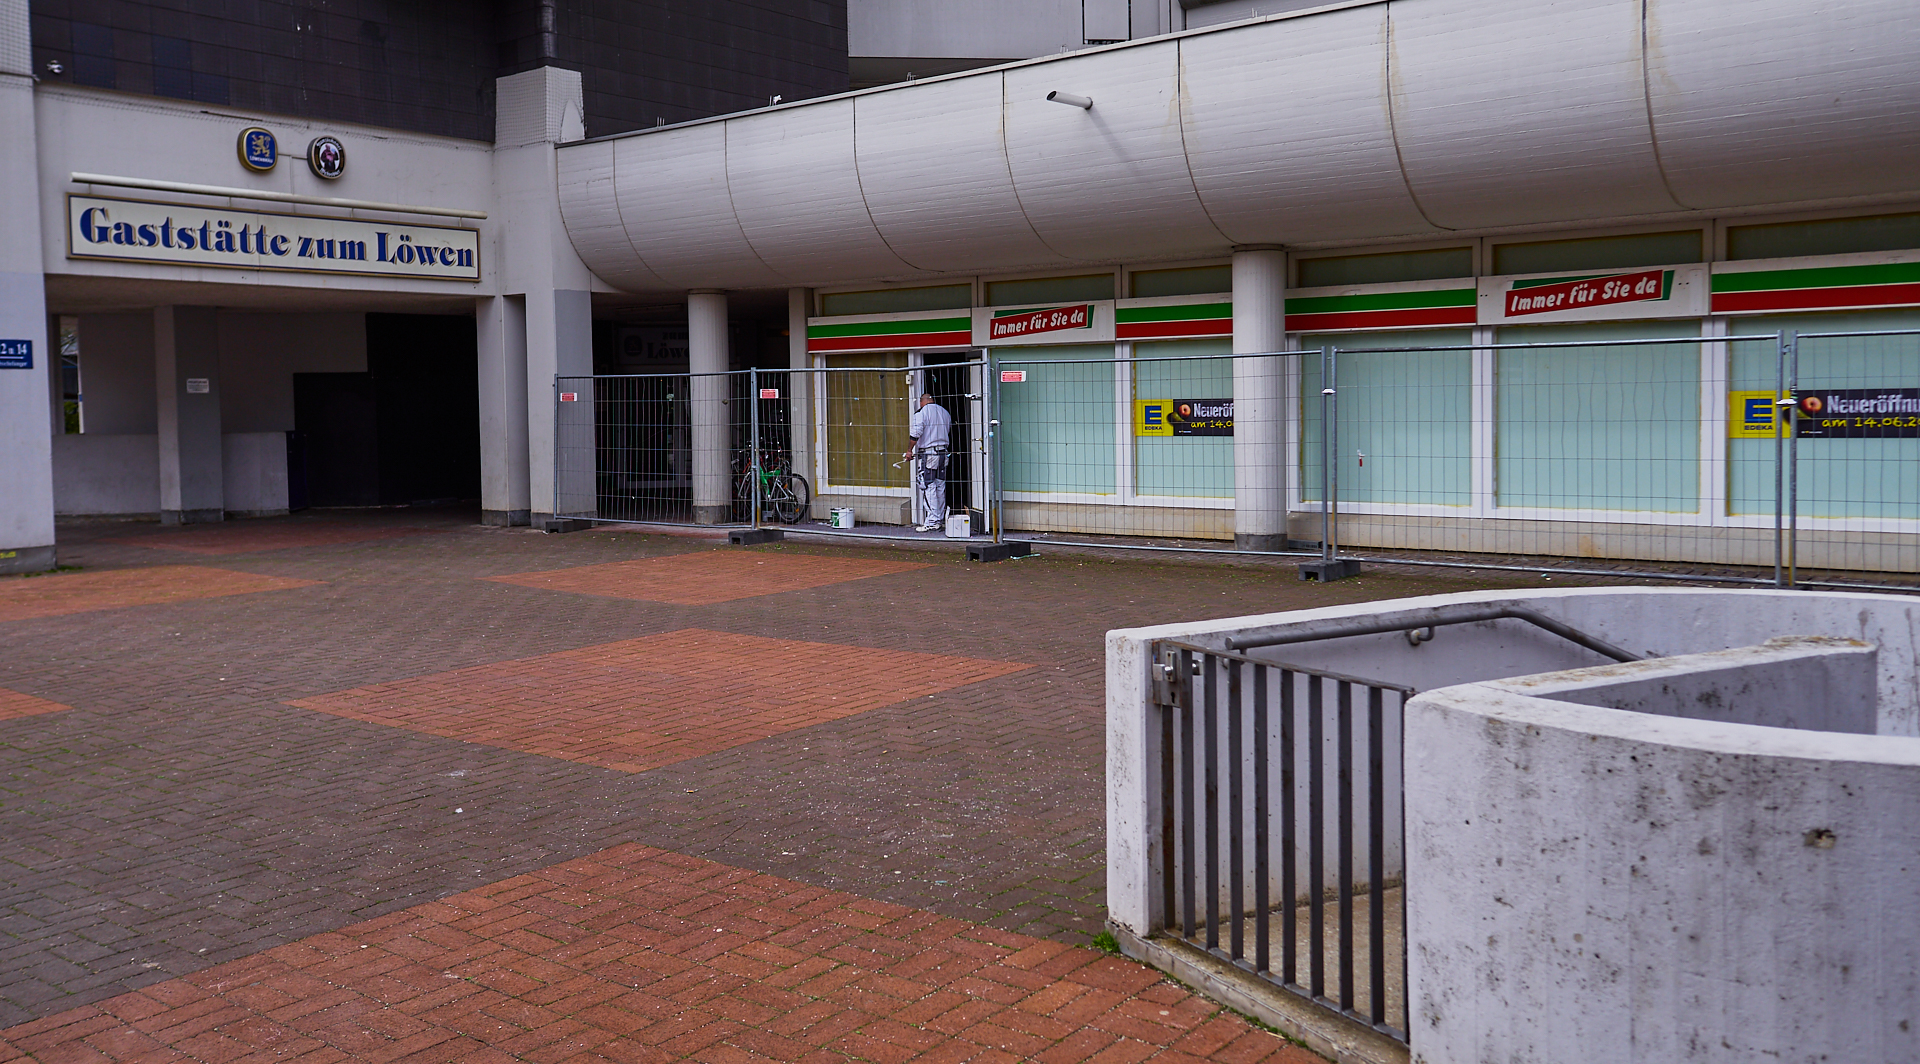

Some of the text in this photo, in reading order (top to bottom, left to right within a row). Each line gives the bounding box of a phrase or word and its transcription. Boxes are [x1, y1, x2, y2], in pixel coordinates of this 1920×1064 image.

[80, 206, 477, 268] Gaststätte zum Löwen
[1510, 276, 1657, 312] Immer für Sie da
[994, 310, 1084, 336] Immer für Sie da
[0, 342, 7, 354] 2
[16, 344, 27, 354] 14
[1210, 420, 1234, 428] 14.0
[1822, 418, 1847, 428] am
